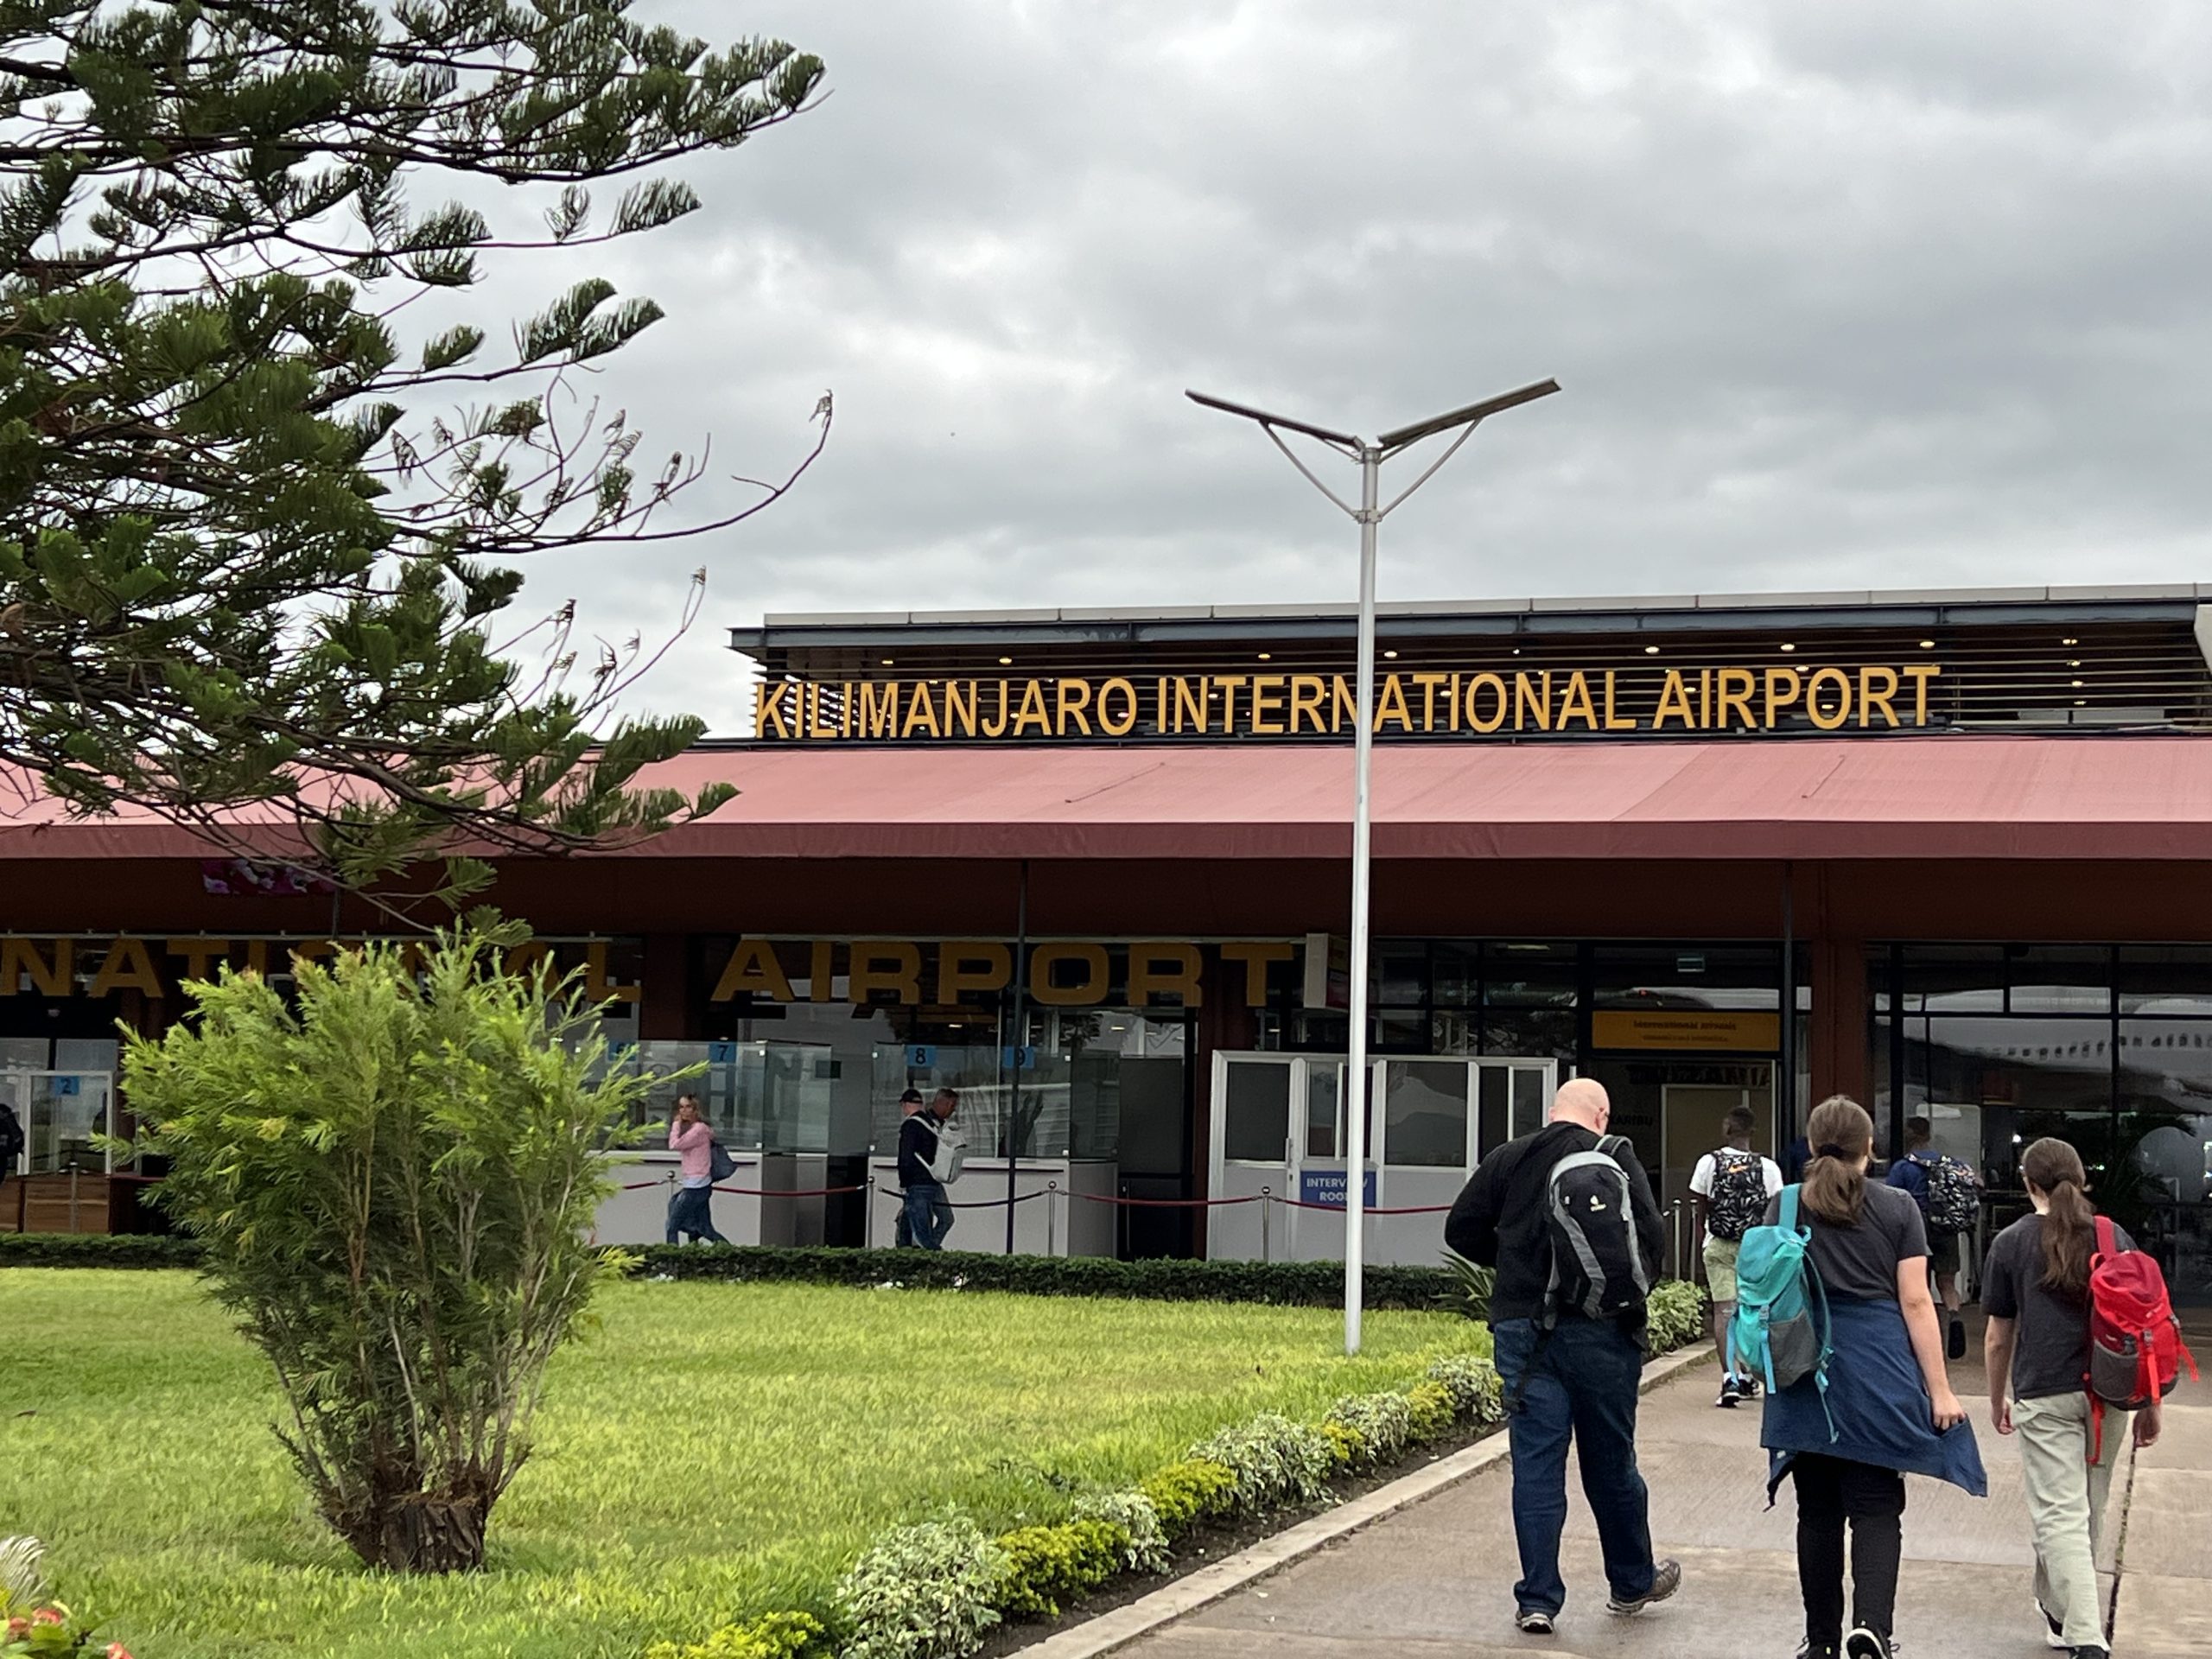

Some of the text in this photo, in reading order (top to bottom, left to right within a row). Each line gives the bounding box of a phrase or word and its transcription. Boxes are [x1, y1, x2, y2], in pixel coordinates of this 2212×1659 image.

[755, 666, 1941, 739] KILIMANJARO INTERNATIONAL AIRPORT
[711, 941, 1294, 1007] AIRPORT
[718, 1045, 728, 1061] 7
[915, 1047, 926, 1065] 8
[60, 1077, 72, 1094] 2
[1306, 1177, 1369, 1189] INTERV
[1319, 1191, 1348, 1202] ROO
